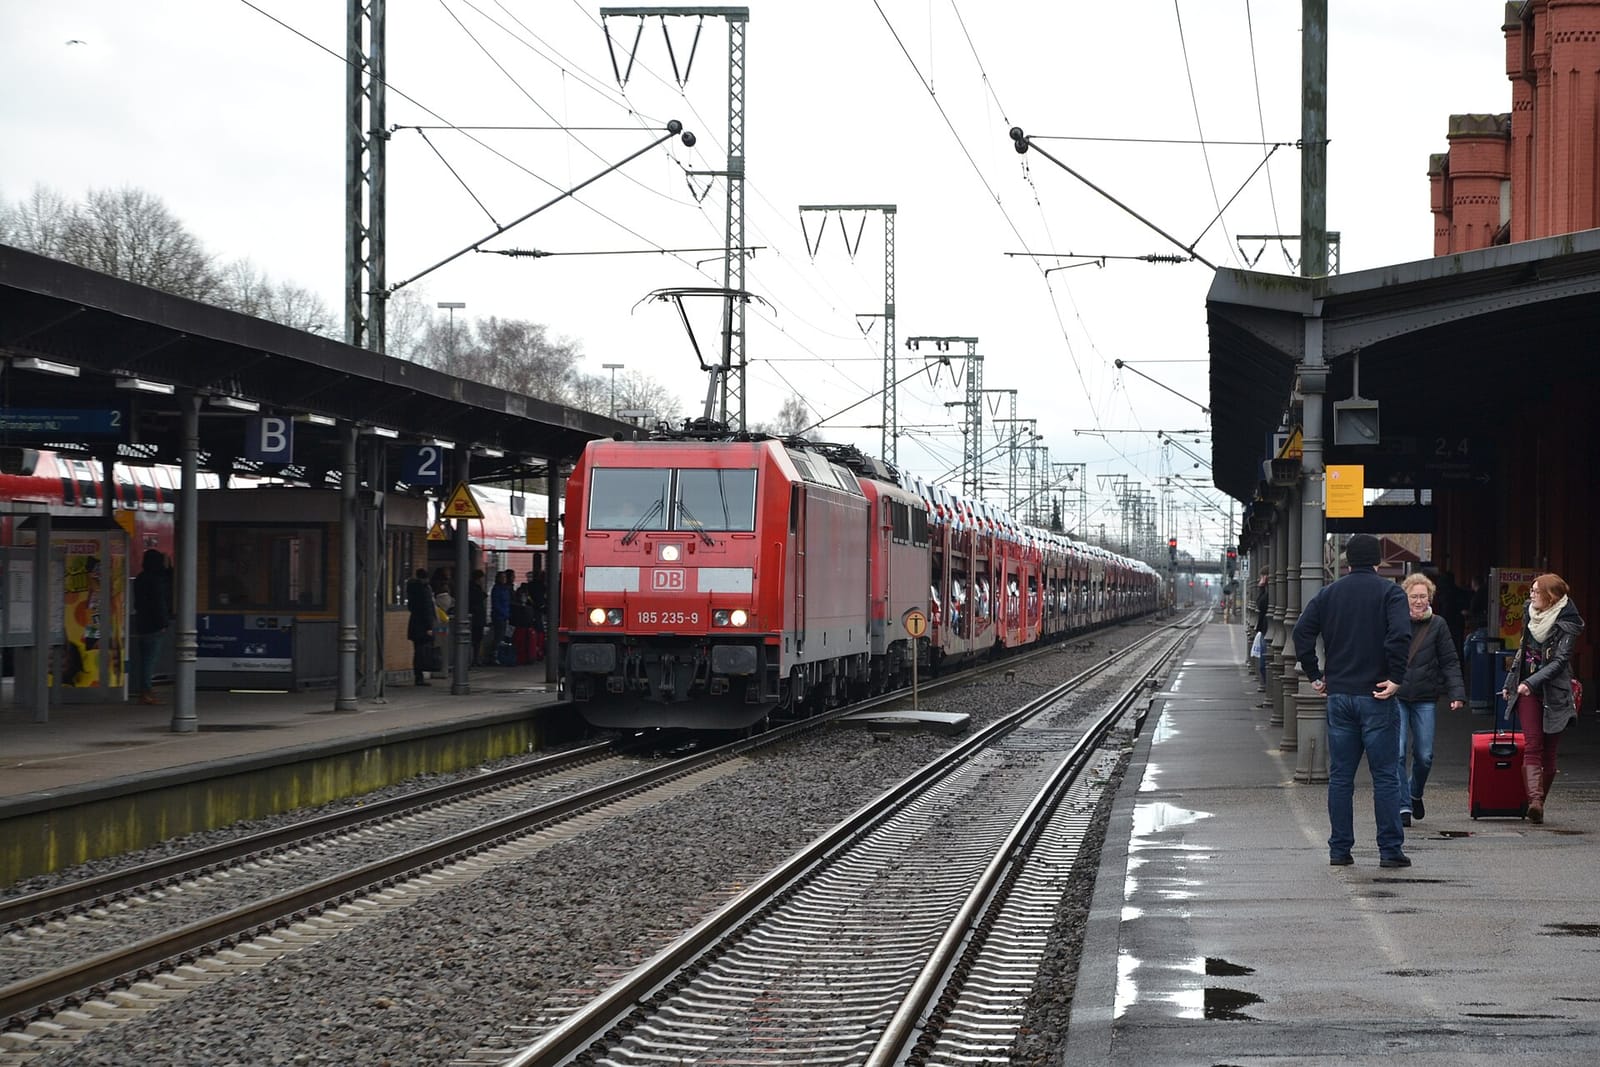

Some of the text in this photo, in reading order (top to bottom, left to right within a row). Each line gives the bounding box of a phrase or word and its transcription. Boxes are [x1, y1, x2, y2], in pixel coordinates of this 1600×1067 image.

[110, 410, 121, 427] 2
[261, 417, 286, 452] B
[417, 446, 437, 476] 2
[655, 571, 682, 587] DB
[1499, 572, 1520, 582] FRISCH
[201, 615, 209, 629] 1
[637, 611, 698, 624] 185 235-9
